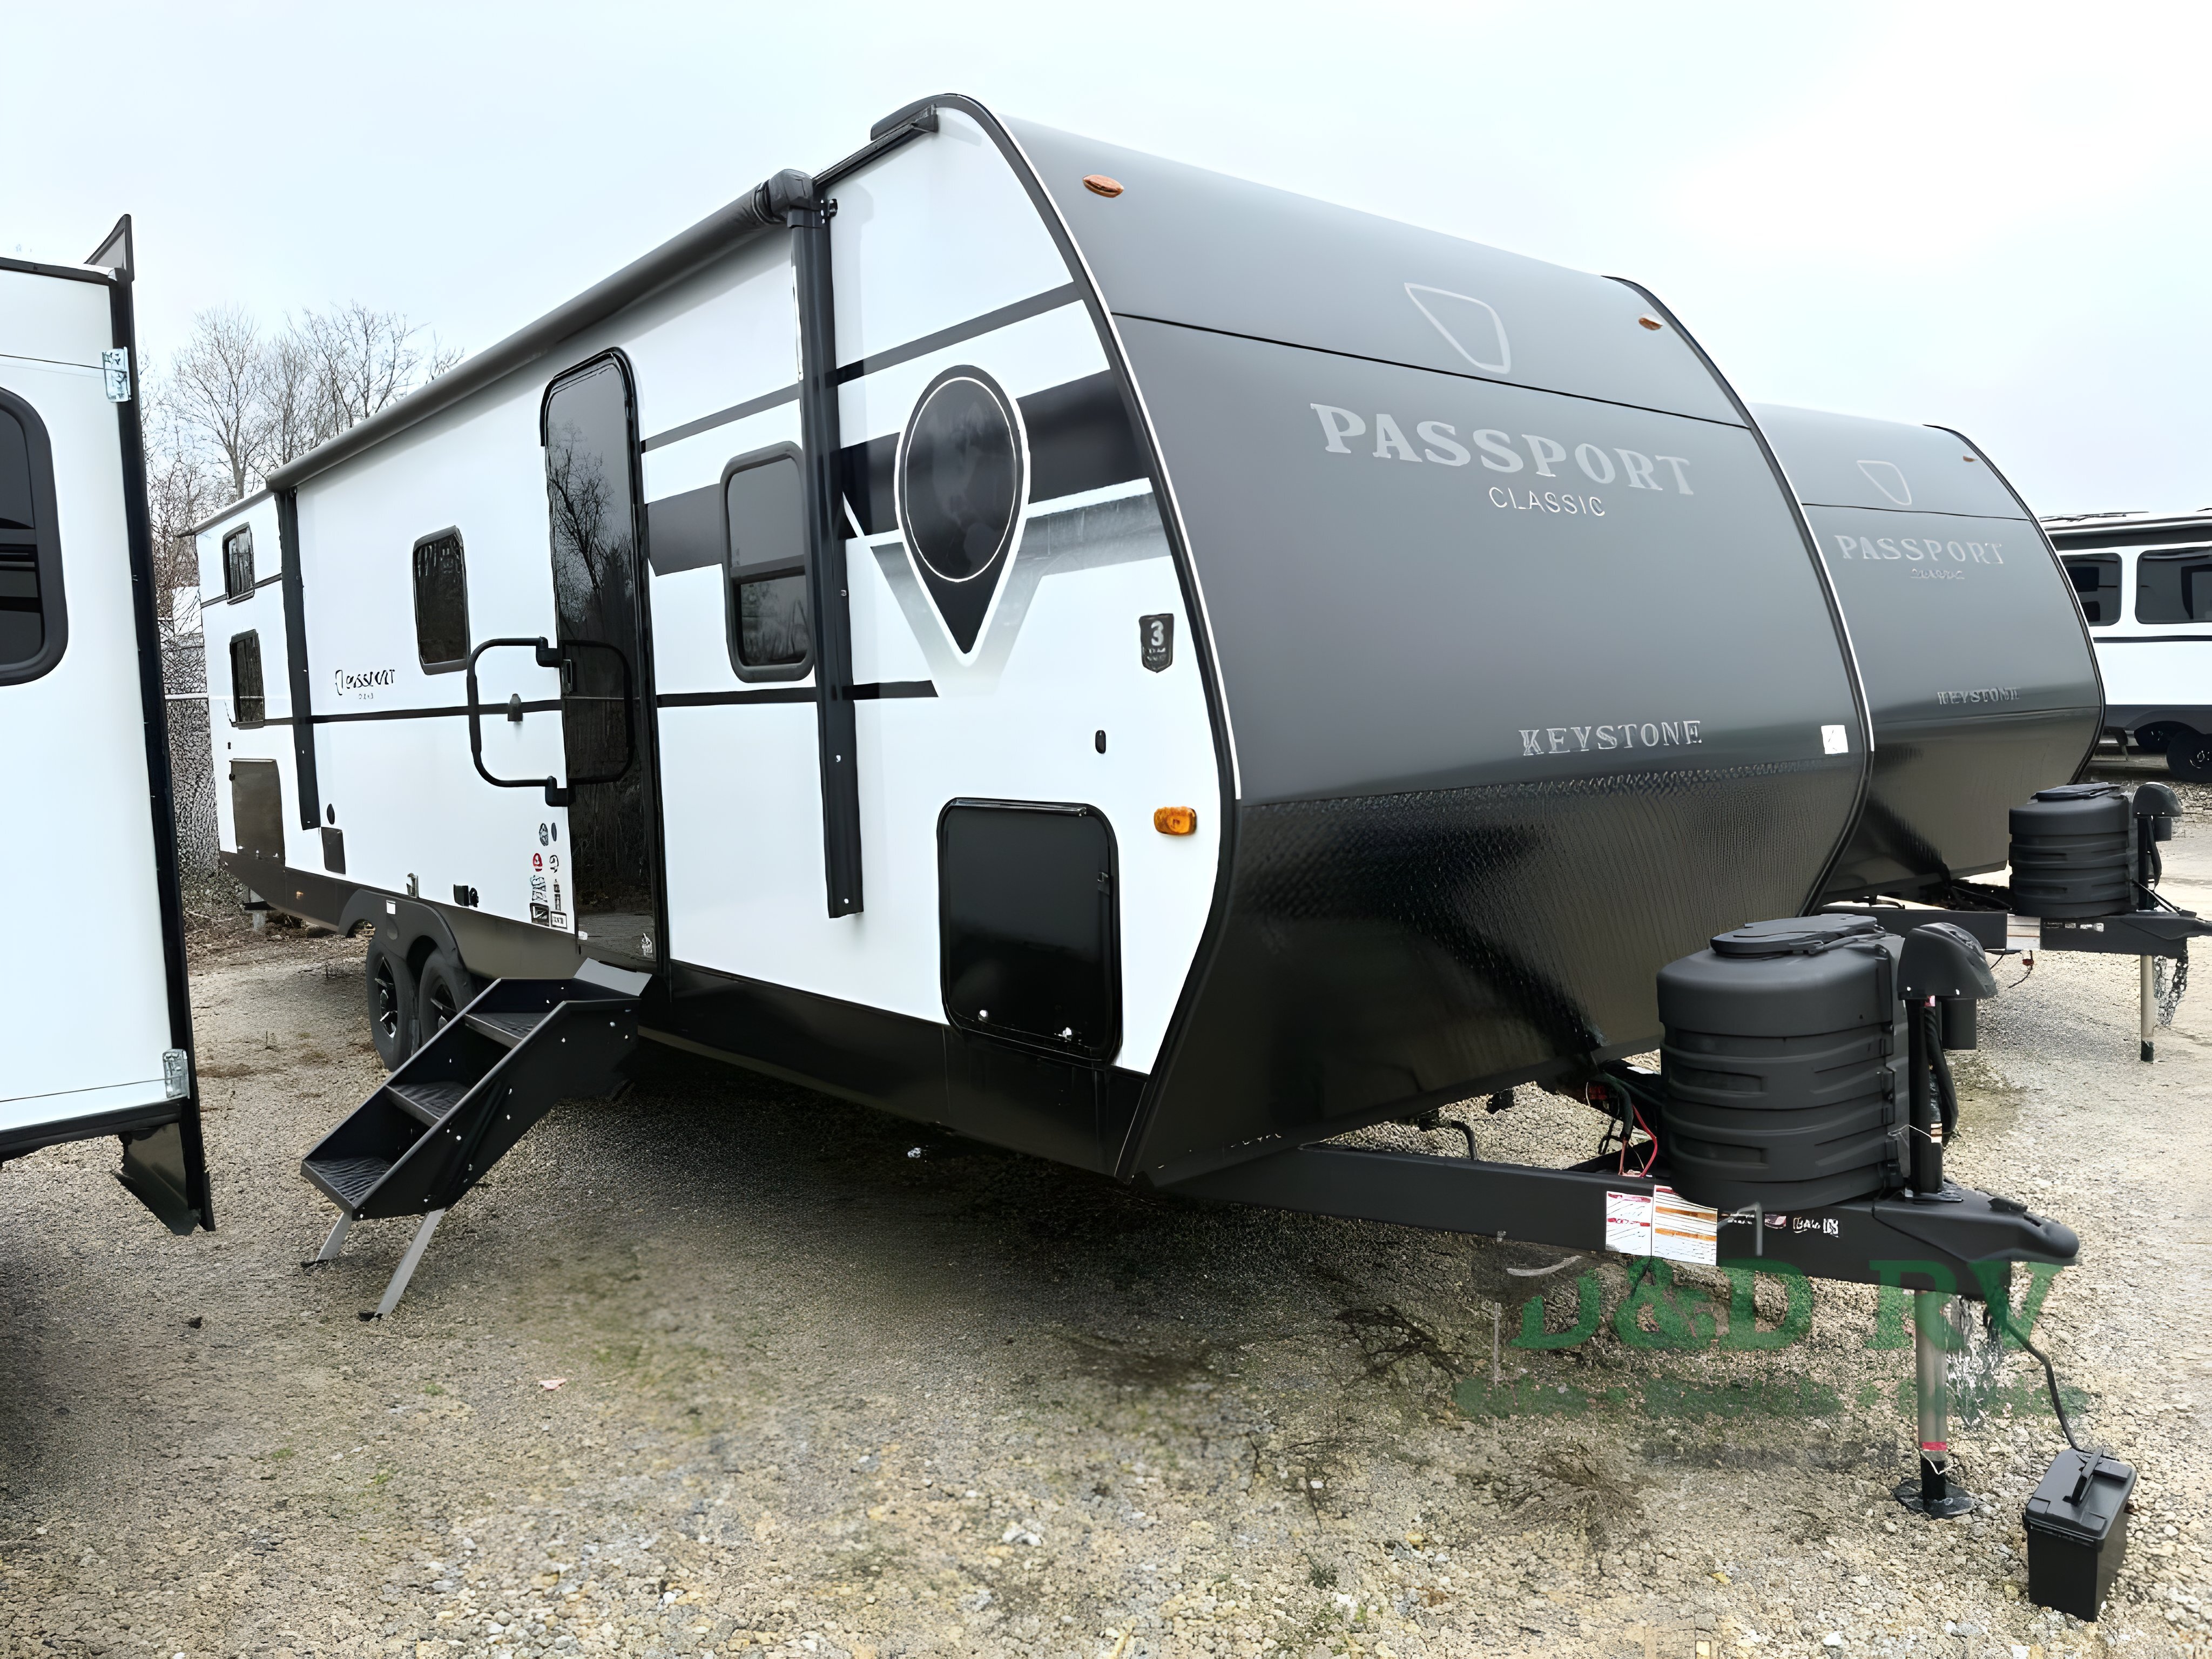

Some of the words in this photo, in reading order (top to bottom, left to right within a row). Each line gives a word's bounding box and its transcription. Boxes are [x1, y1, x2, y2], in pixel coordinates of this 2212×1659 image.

[1310, 402, 1694, 495] PASSPORT
[1488, 486, 1606, 517] CLASSIC
[1834, 535, 2004, 564] PASSPORT
[1150, 620, 1164, 646] 3
[1518, 720, 1702, 756] KEYSTONE
